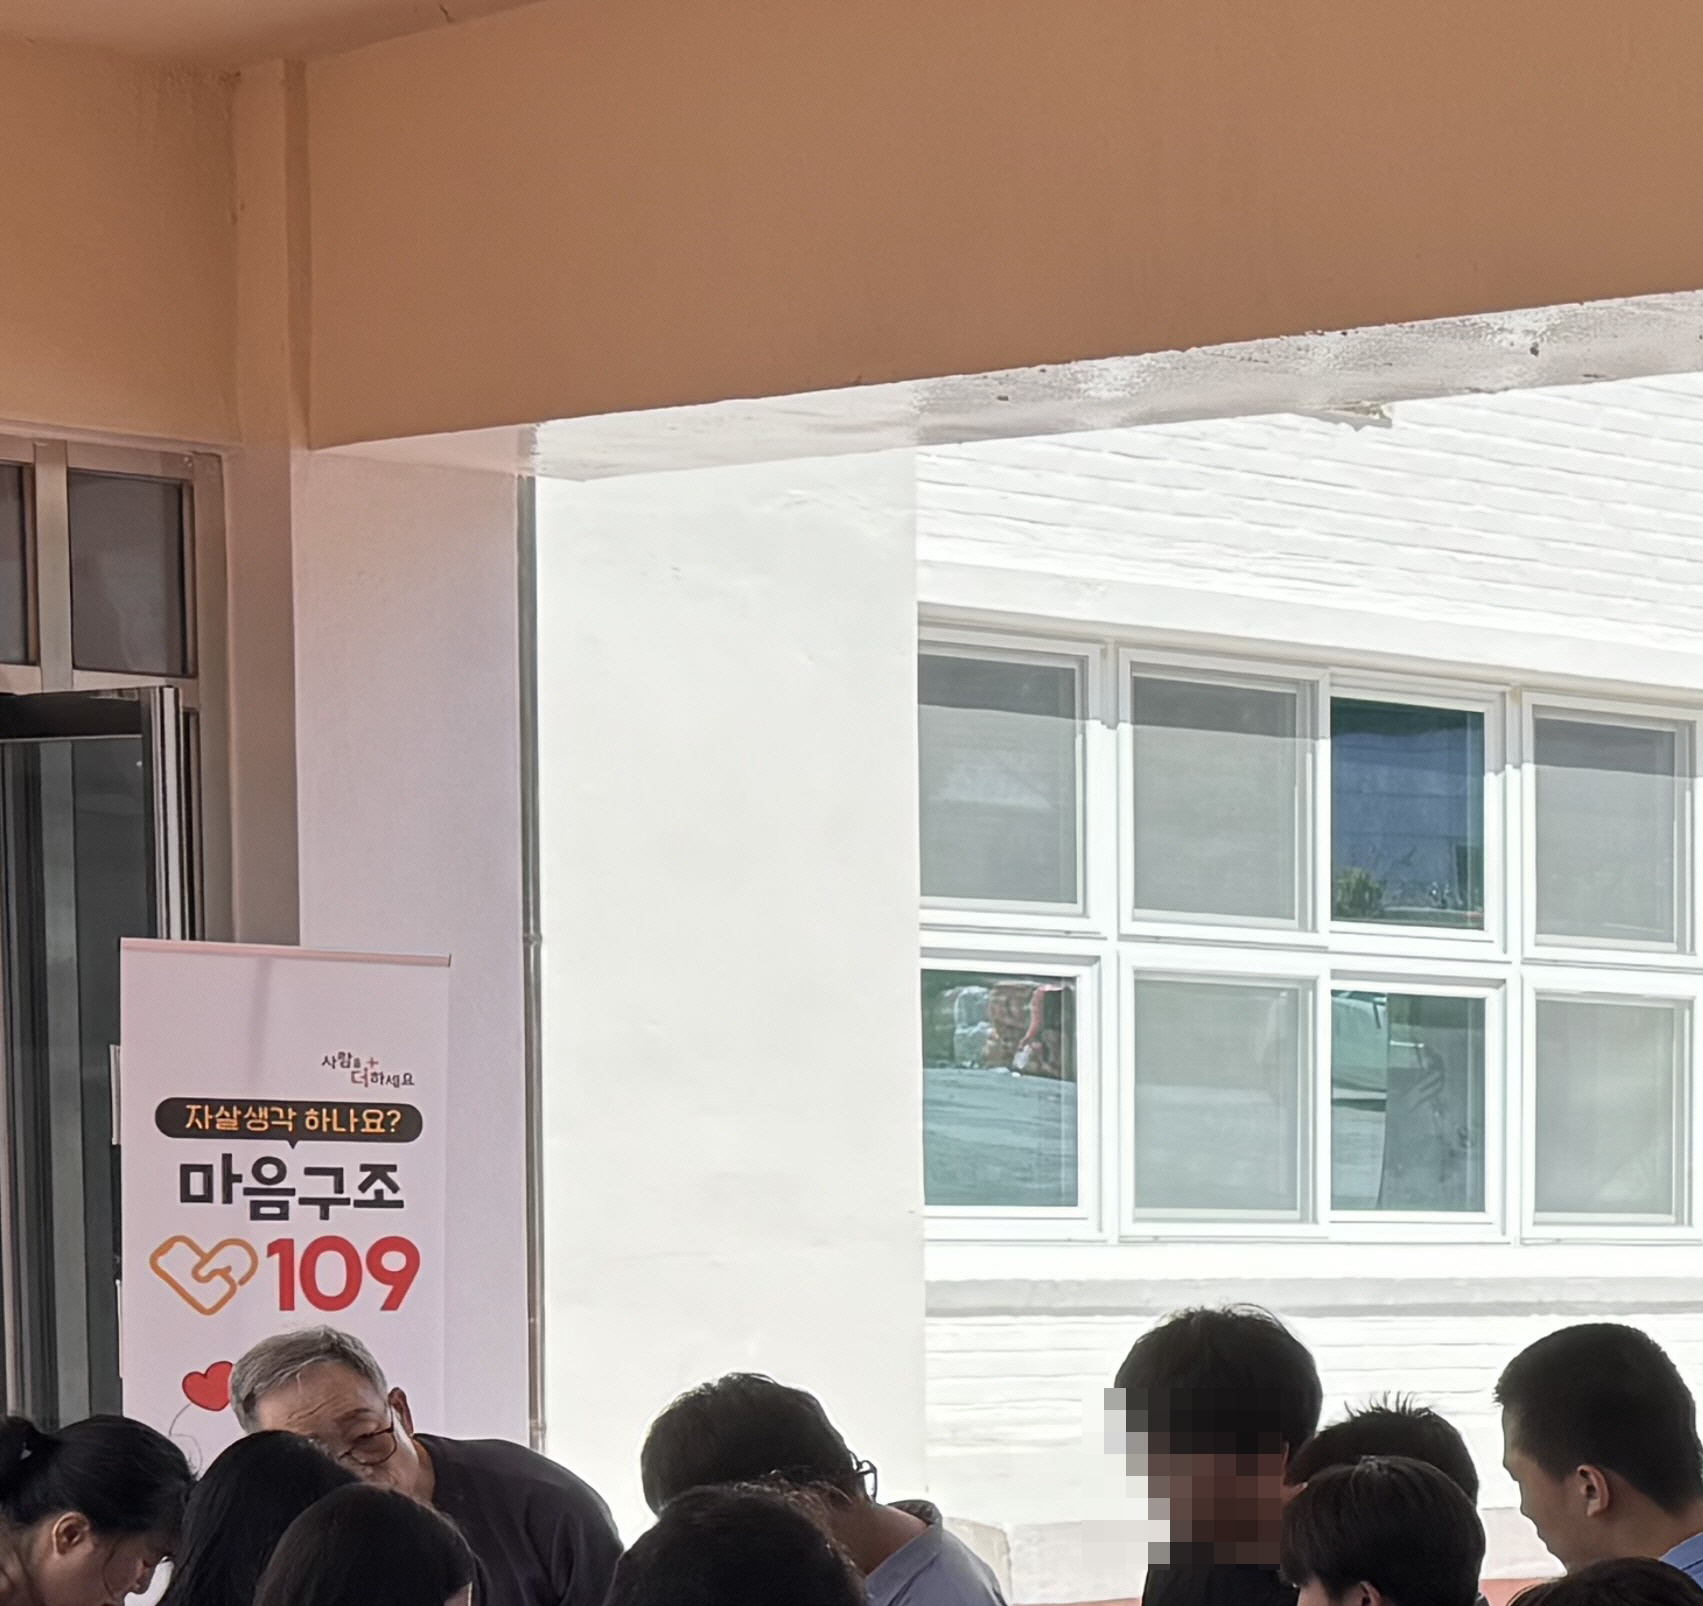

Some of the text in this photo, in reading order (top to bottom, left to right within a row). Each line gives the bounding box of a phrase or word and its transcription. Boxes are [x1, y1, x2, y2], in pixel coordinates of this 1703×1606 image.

[185, 1104, 402, 1134] 자살생각 하나요?
[179, 1153, 405, 1222] 마음구조
[266, 1235, 421, 1312] 109
